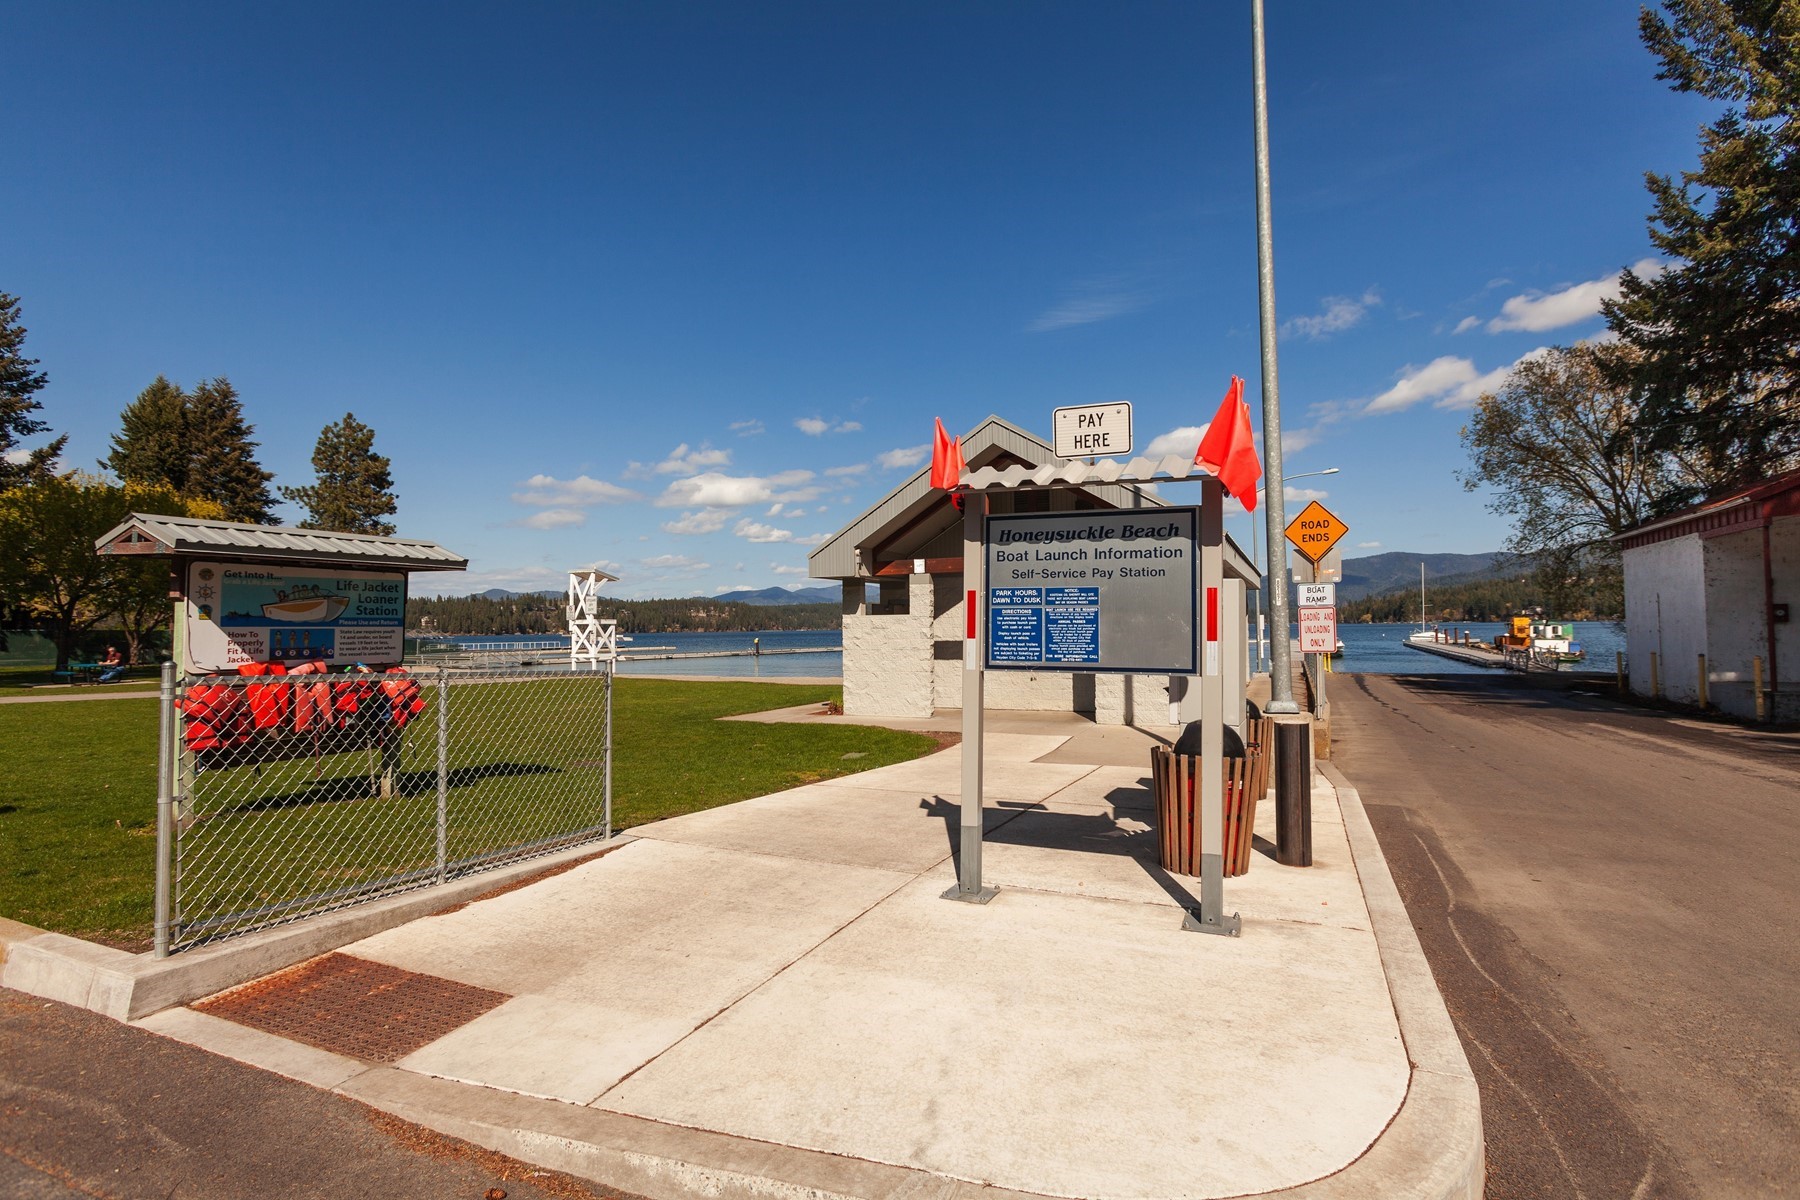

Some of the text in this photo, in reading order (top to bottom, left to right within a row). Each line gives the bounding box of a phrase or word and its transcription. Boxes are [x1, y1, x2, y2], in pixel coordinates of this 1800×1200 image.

[1078, 412, 1104, 428] PAY
[1074, 433, 1110, 449] HERE
[1301, 520, 1330, 529] ROAD
[999, 523, 1180, 544] Honeysuckle Beach
[1302, 533, 1329, 542] ENDS
[996, 546, 1183, 562] Boat Launch Information
[224, 570, 242, 578] Get
[1012, 566, 1166, 579] Self-Service Pay Station
[336, 581, 399, 592] Life Jacket
[358, 594, 399, 604] Loaner
[356, 605, 398, 616] Station
[1301, 612, 1334, 621] LOADING AND
[1304, 625, 1330, 633] UNLOADING
